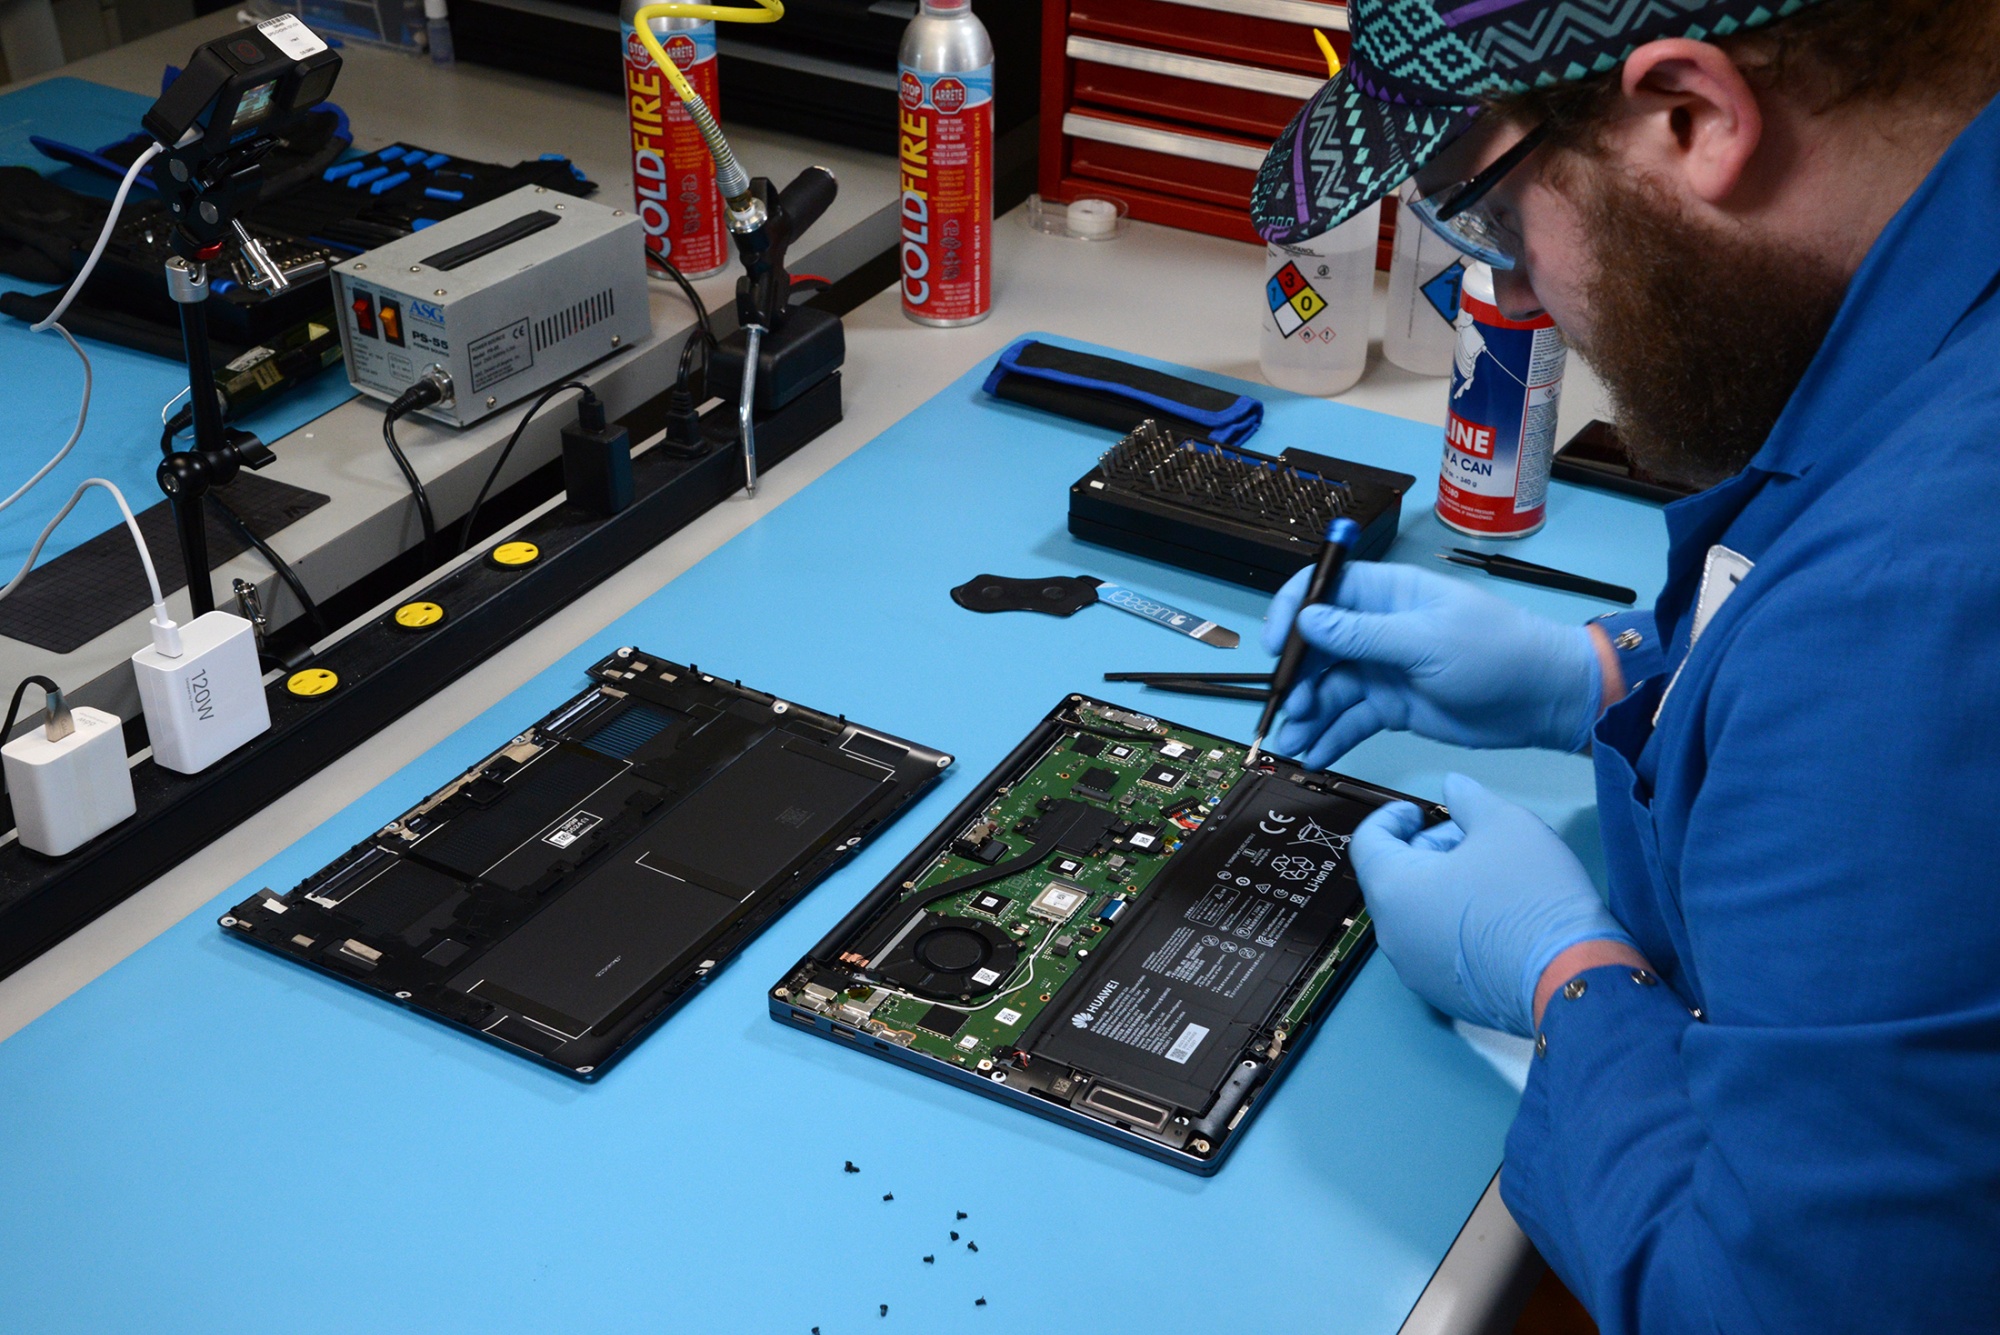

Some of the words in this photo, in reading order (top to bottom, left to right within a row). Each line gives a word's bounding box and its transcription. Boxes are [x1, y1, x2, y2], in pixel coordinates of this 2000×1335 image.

[901, 80, 921, 97] STOP
[935, 88, 963, 101] ARRÊTE
[1285, 272, 1294, 288] 3
[1271, 288, 1276, 301] 1
[1445, 274, 1460, 310] 1
[409, 300, 445, 324] ASG
[1301, 296, 1312, 311] 0
[412, 331, 449, 350] PS-55
[1447, 418, 1490, 454] INE
[1450, 453, 1457, 466] A
[1461, 458, 1492, 477] CAN
[191, 668, 215, 721] 120W
[1304, 871, 1329, 892] Li-ion
[1086, 980, 1120, 1014] HUAWEI
